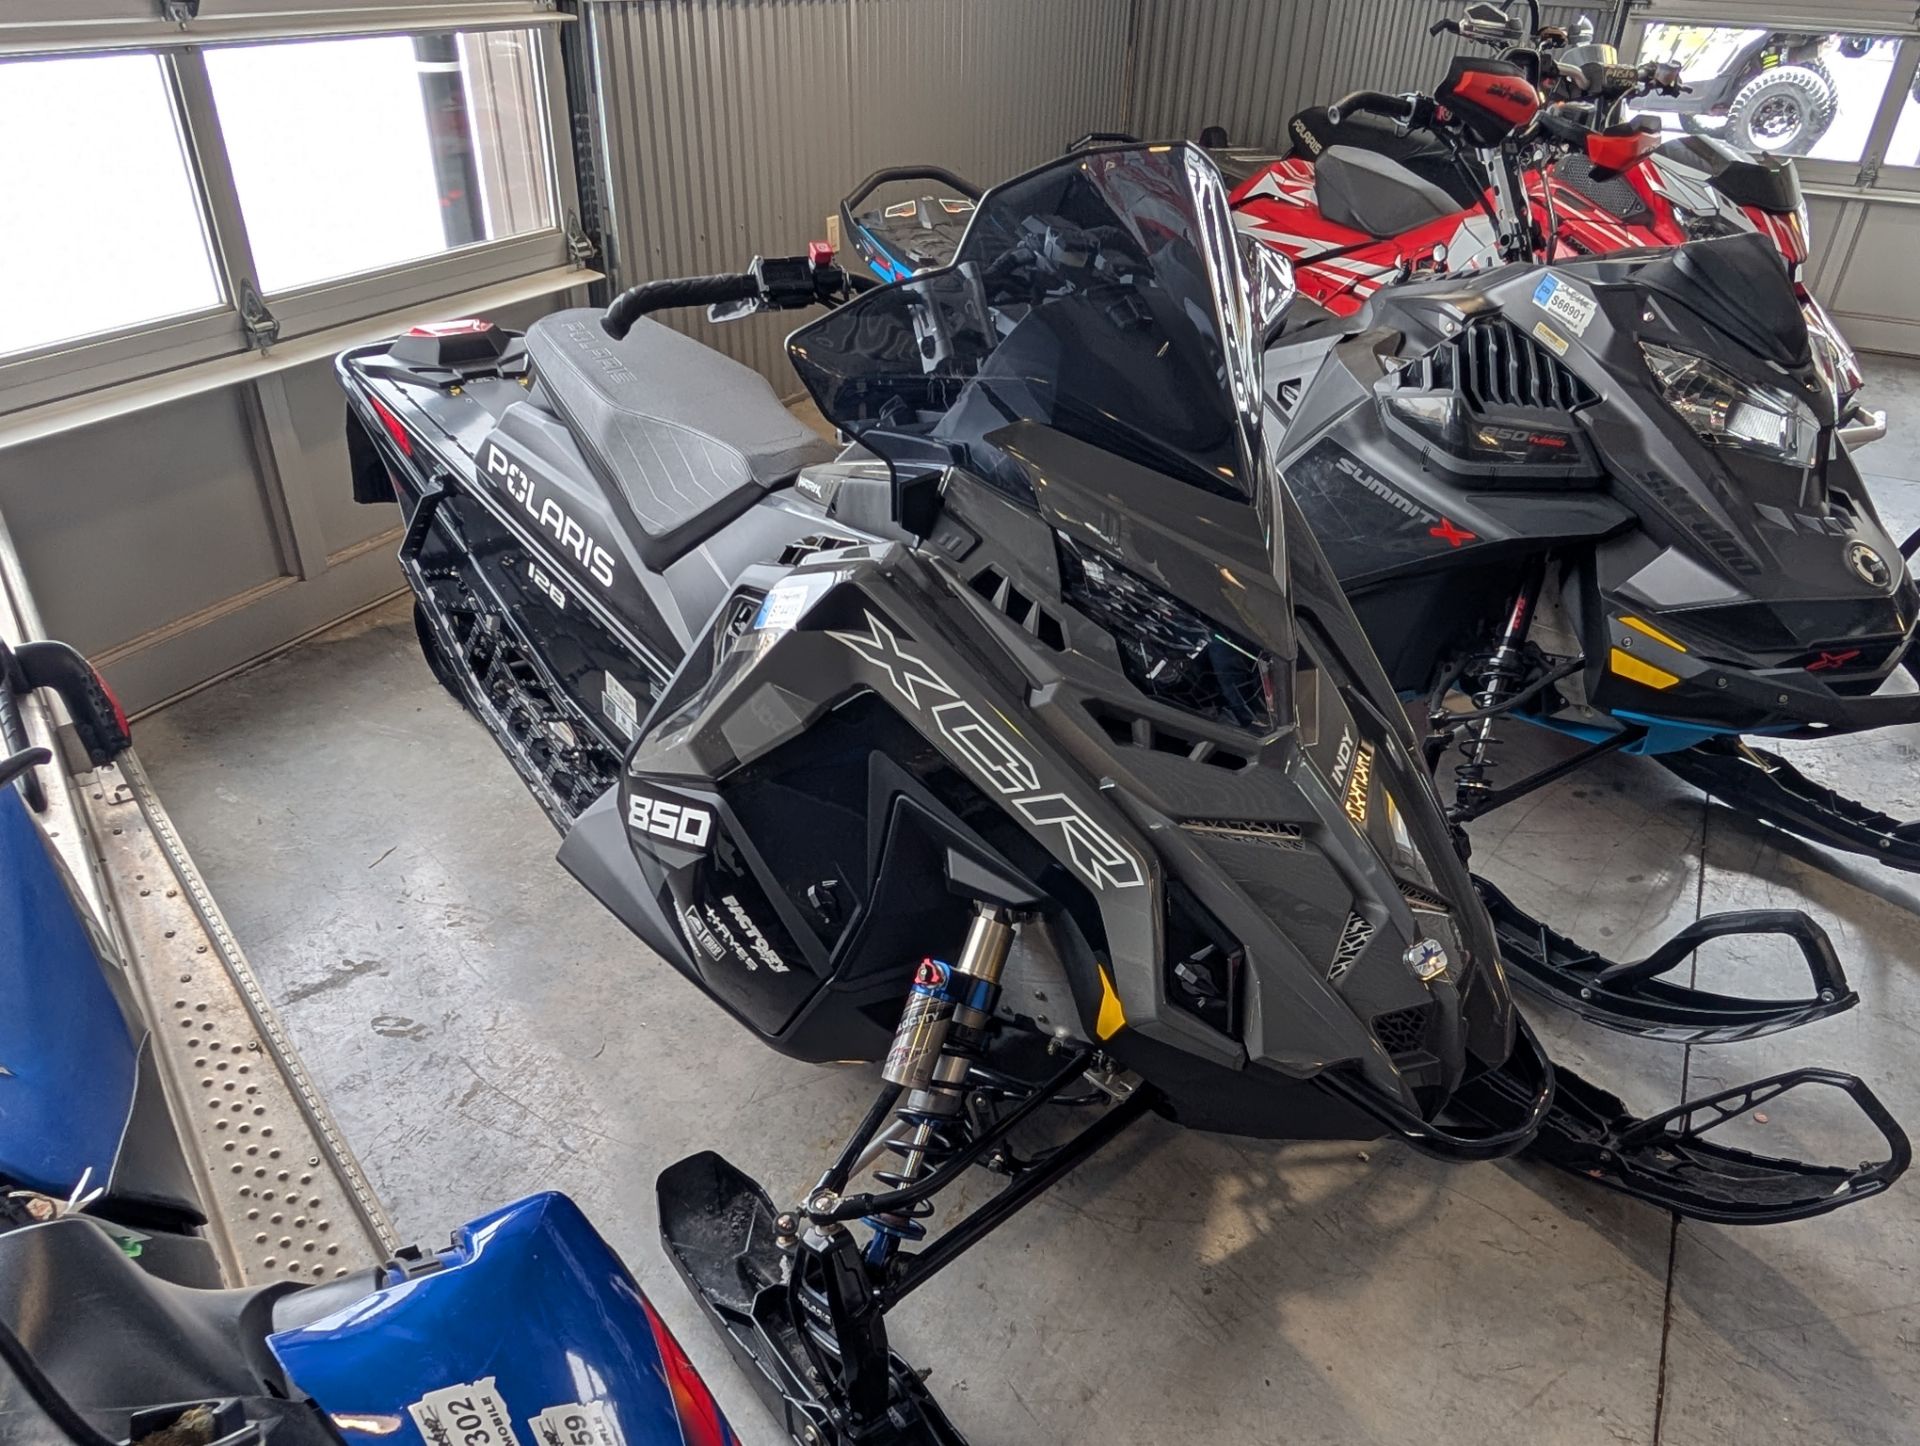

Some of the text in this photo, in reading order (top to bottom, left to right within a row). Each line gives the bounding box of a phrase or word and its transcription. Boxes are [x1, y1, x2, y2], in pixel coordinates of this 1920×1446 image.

[1292, 119, 1322, 154] POLARIS
[561, 320, 639, 384] POLARIS
[487, 443, 616, 588] POLARIS
[1335, 457, 1476, 547] SUMMIT X
[528, 562, 566, 609] 128
[824, 608, 1145, 890] XCR
[1332, 724, 1353, 787] INDY
[628, 794, 711, 847] 850
[704, 902, 759, 971] HAYES
[722, 895, 791, 973] FACTORY
[448, 1397, 490, 1446] 302
